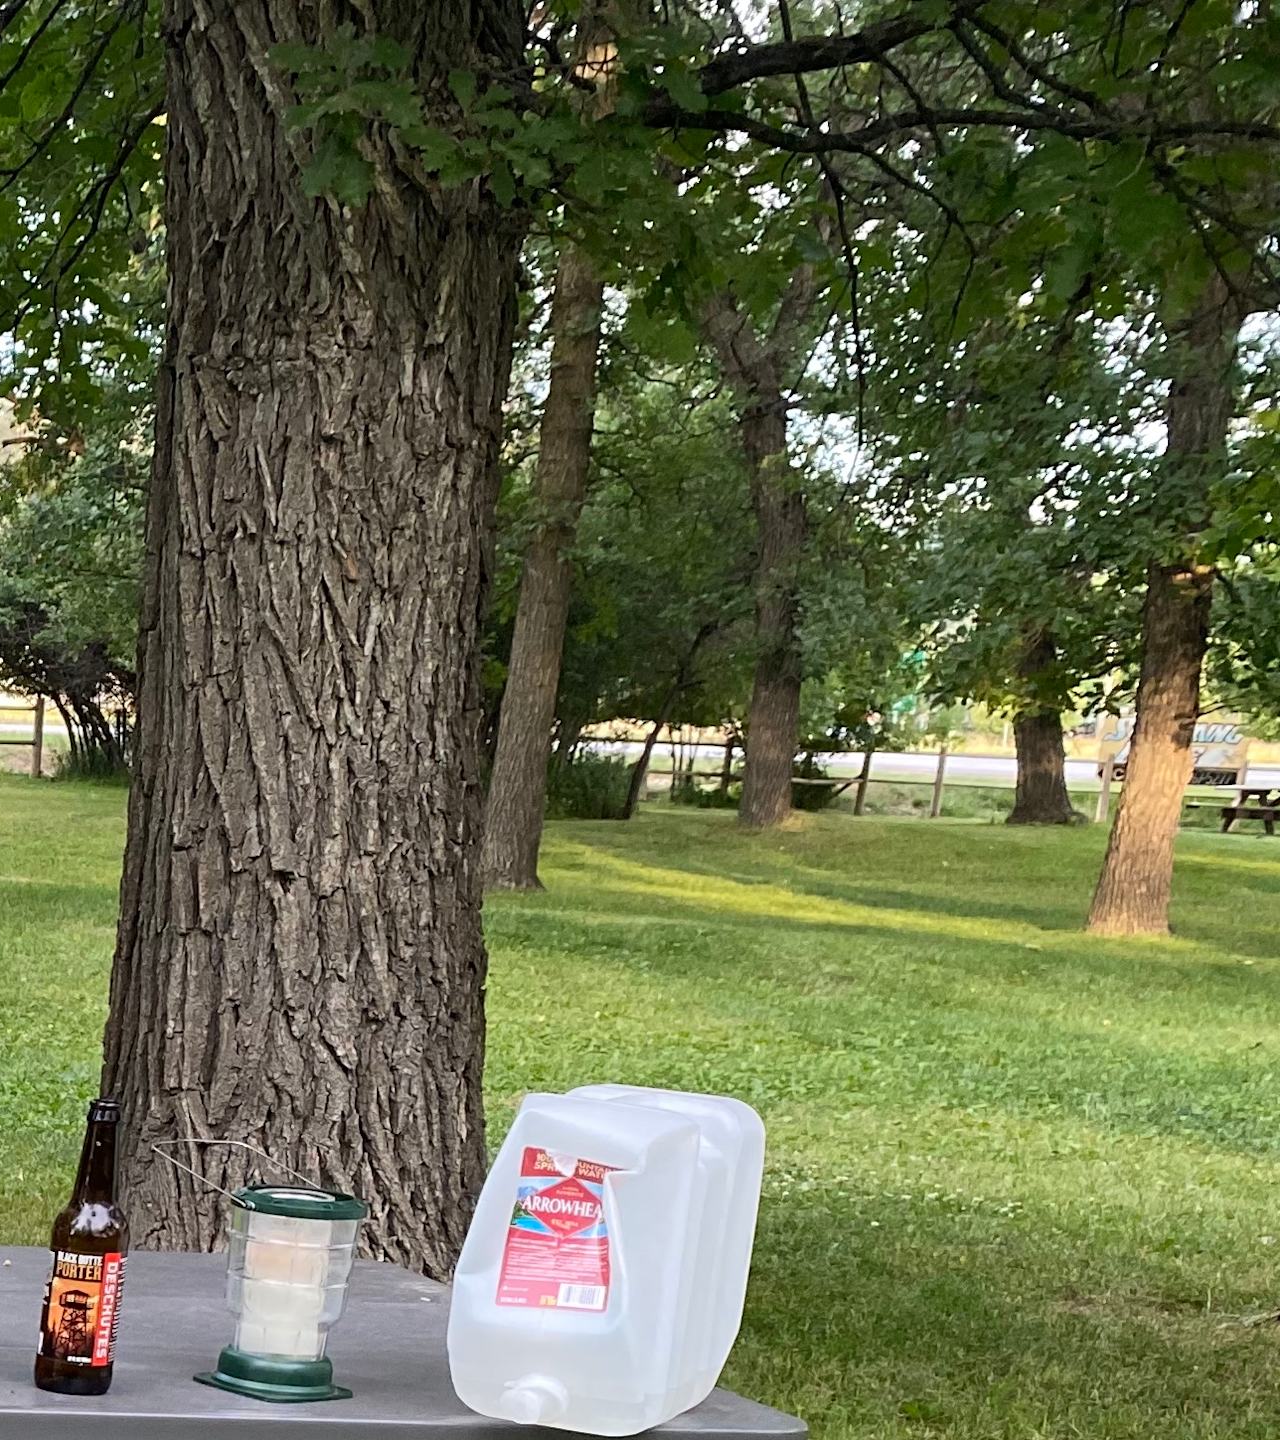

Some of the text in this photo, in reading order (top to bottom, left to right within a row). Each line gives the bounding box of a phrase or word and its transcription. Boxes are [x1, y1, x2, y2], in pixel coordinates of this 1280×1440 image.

[521, 1195, 602, 1217] ARROWHEA
[56, 1261, 102, 1280] PORTER
[96, 1261, 119, 1359] DESCHUTES
